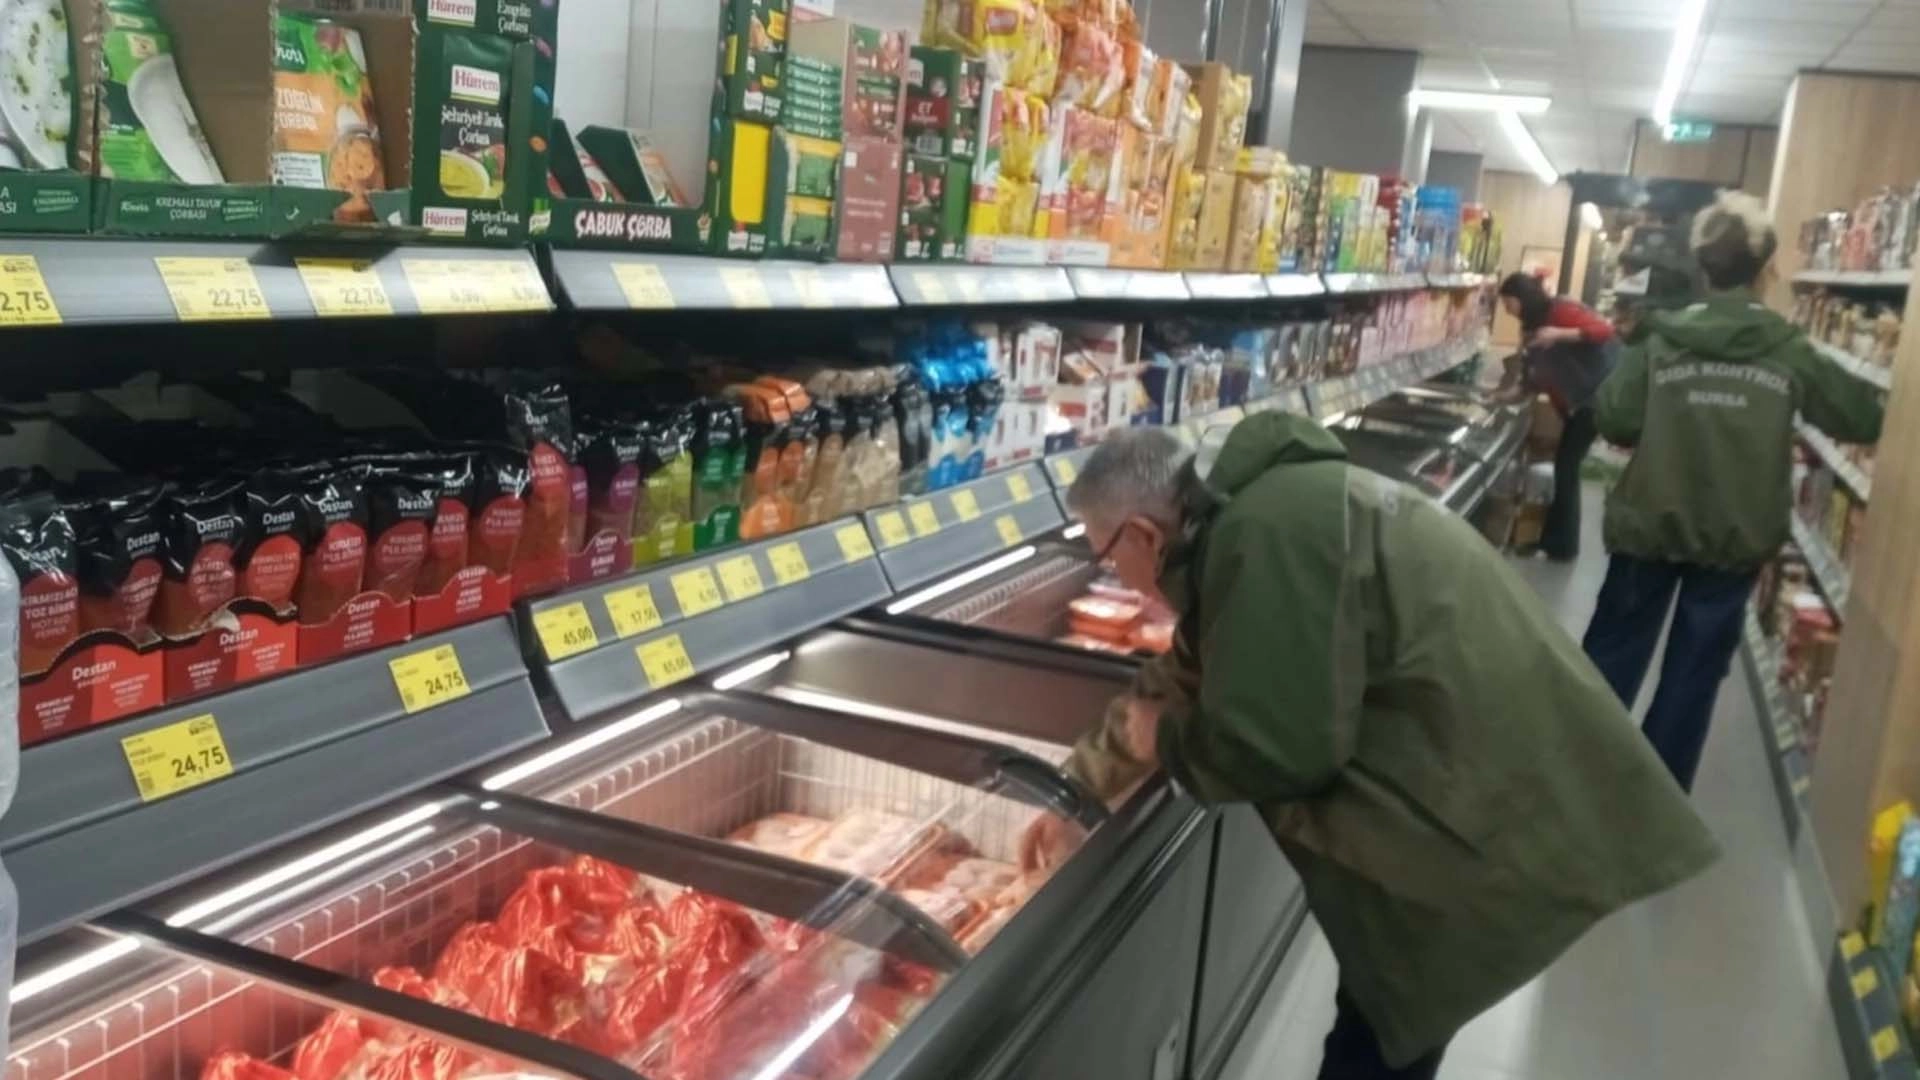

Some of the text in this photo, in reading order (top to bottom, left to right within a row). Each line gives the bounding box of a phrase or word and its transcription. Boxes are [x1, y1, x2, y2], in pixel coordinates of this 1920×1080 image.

[454, 69, 498, 92] Hürrem
[425, 211, 465, 225] Hürrem
[574, 210, 625, 238] ÇABUK
[627, 213, 673, 241] ÇORBA
[207, 288, 263, 307] 22,75
[340, 287, 385, 306] 22,75
[1701, 361, 1791, 397] KONTROL
[1687, 390, 1747, 408] BURSA
[319, 499, 353, 514] Destan
[197, 518, 235, 535] Destan
[262, 511, 296, 526] Destan
[127, 531, 160, 552] Destan
[218, 627, 259, 646] Destan
[563, 625, 593, 647] 45,00
[71, 660, 117, 681] Destan
[424, 670, 464, 696] 24,75
[171, 745, 225, 778] 24,75
